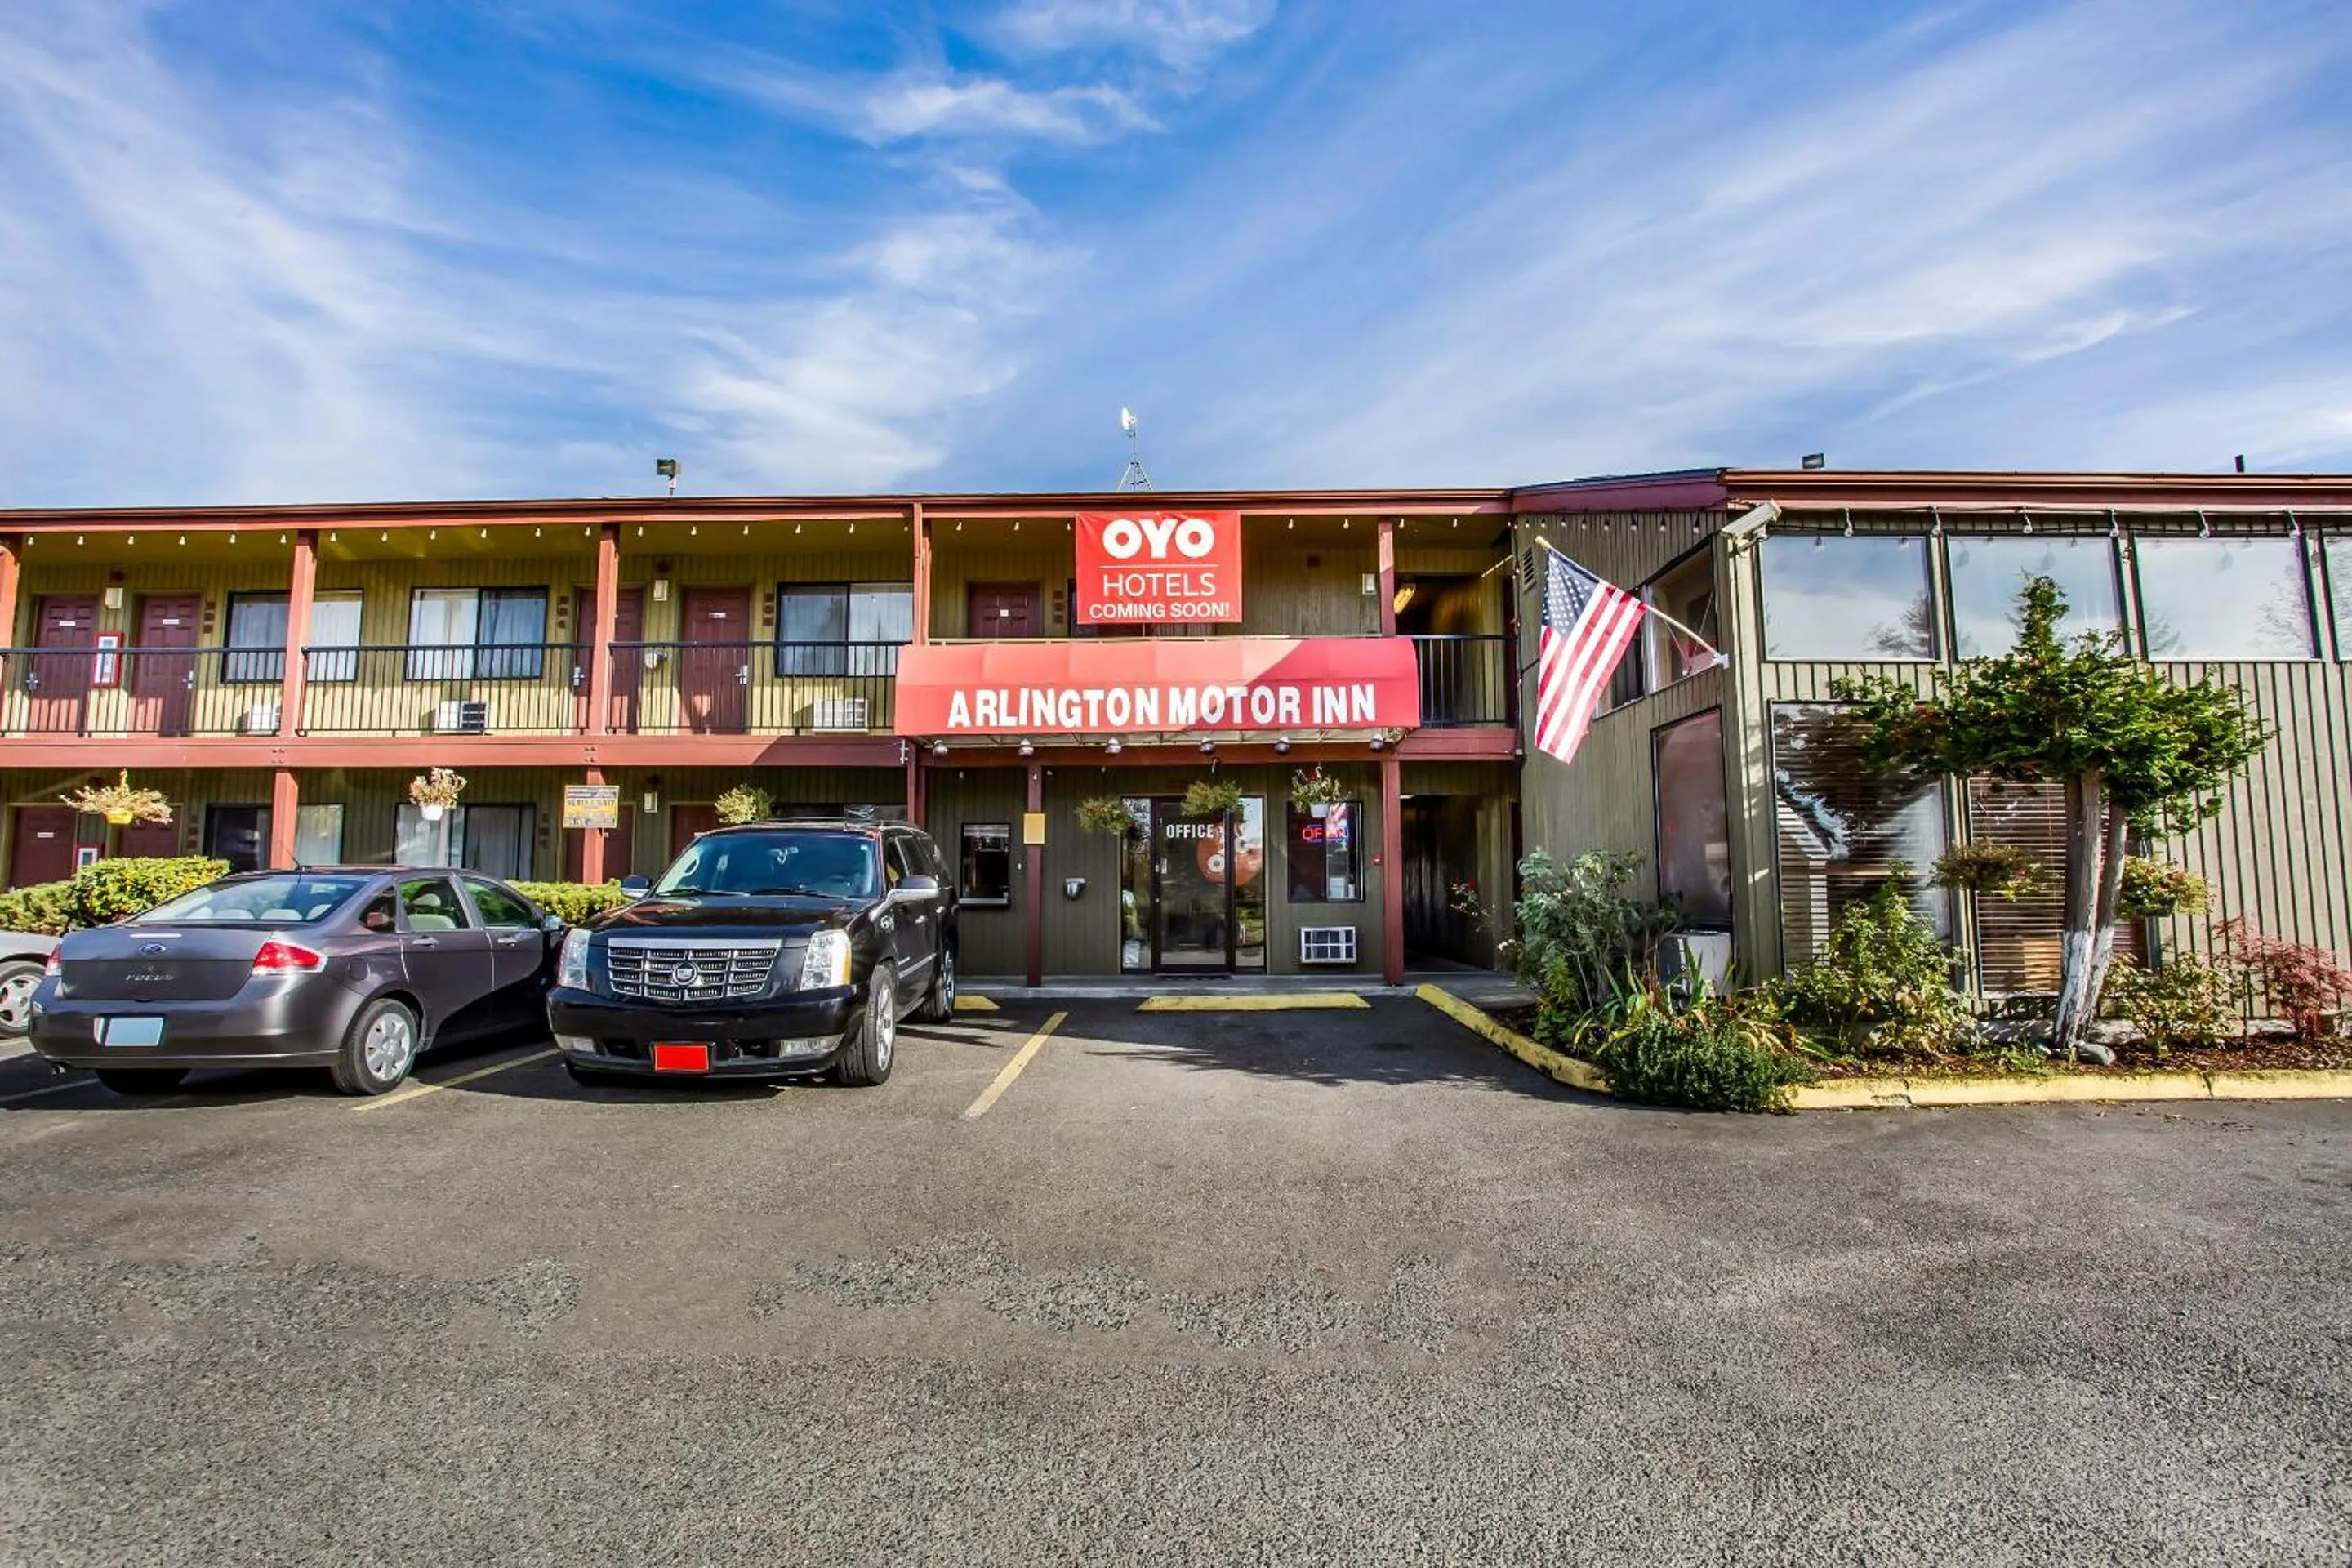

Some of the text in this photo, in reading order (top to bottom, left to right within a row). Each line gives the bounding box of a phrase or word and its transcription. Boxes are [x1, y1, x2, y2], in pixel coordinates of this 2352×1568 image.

[1102, 518, 1215, 559] OYO
[1102, 572, 1216, 597] HOTELS
[1089, 601, 1230, 619] COMING SOON!
[947, 683, 1377, 728] ARLINGTON MOTOR INN
[1166, 824, 1214, 839] OFFICE
